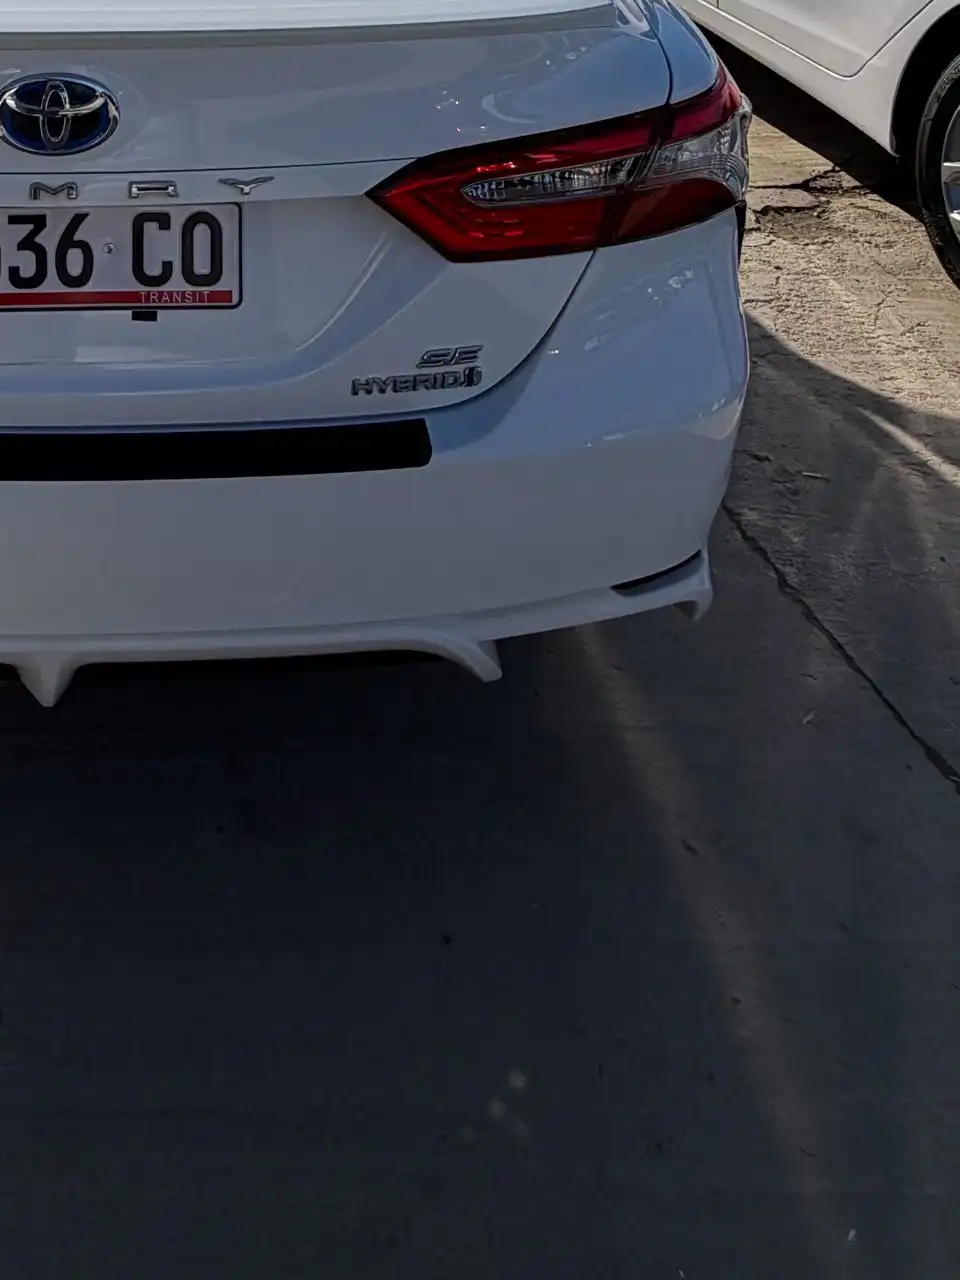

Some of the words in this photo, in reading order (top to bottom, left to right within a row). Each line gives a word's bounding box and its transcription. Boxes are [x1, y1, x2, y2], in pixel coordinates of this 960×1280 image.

[131, 211, 224, 288] CO
[138, 290, 212, 304] TRANSIT
[415, 344, 484, 369] SE
[350, 371, 461, 396] HYBRID
